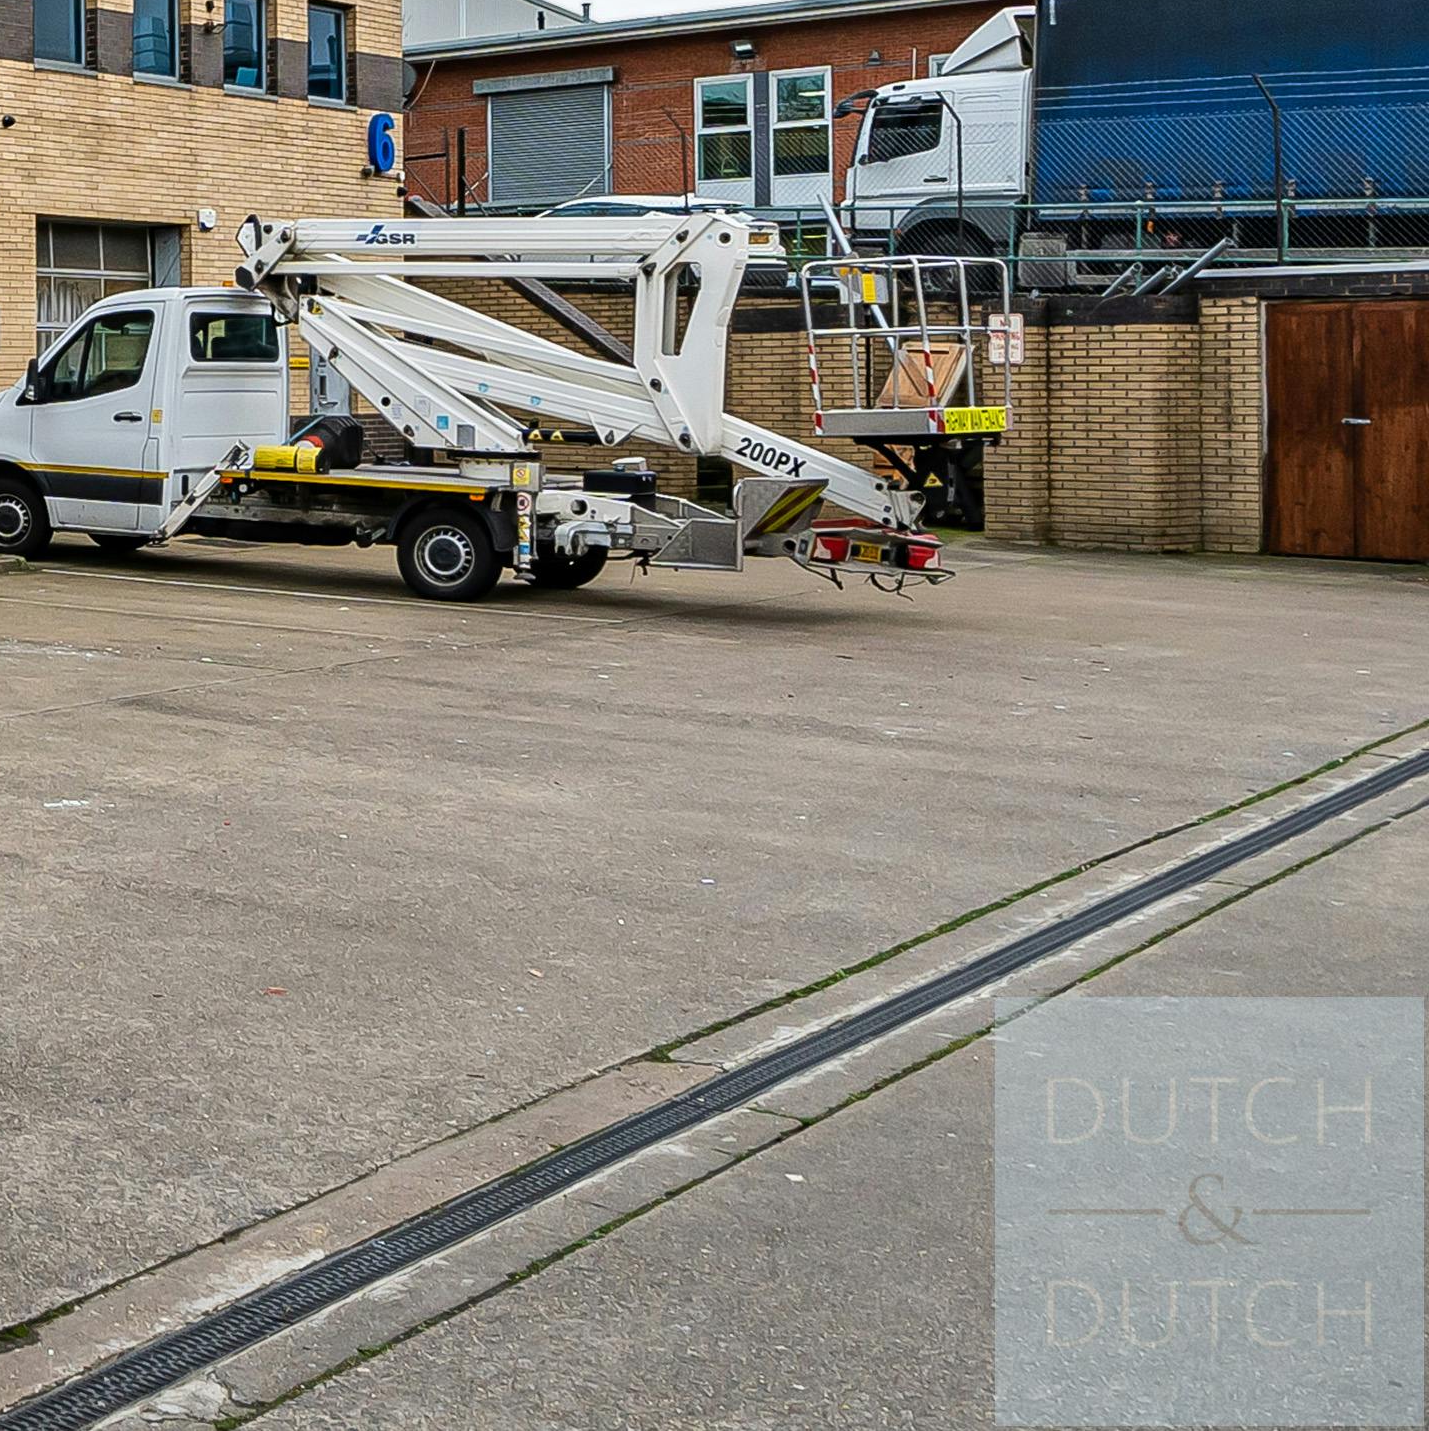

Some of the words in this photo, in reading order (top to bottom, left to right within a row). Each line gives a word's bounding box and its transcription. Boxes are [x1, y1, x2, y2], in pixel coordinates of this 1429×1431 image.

[367, 112, 396, 173] 6
[376, 232, 416, 245] GSR
[735, 436, 808, 478] 200PX
